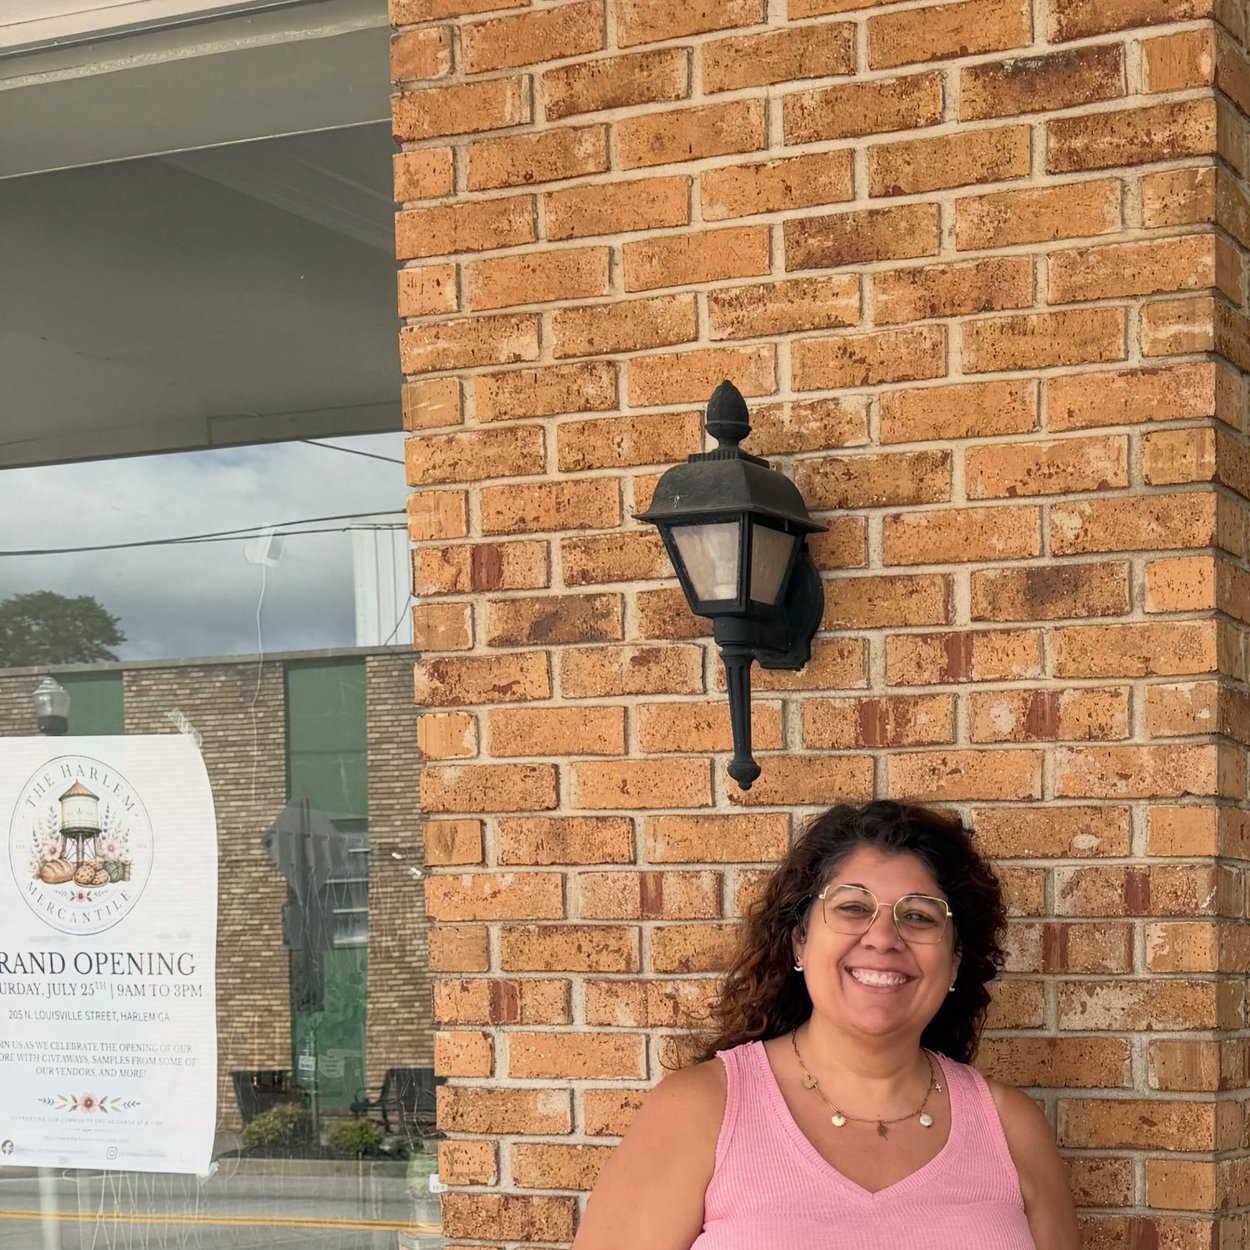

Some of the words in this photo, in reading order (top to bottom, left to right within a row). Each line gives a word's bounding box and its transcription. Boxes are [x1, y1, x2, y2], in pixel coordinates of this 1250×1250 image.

[25, 772, 55, 808] THE
[60, 763, 135, 812] HARLEM
[25, 881, 131, 924] MERCANTILE
[0, 951, 65, 974] RAND
[74, 952, 196, 976] OPENING
[0, 982, 44, 997] URDAY,
[46, 982, 77, 999] JULY
[117, 983, 146, 997] 9AM
[148, 984, 170, 997] TO
[174, 984, 203, 998] 3PM
[8, 1009, 23, 1020] 205
[35, 1010, 82, 1021] LOUISVILLE
[84, 1010, 119, 1023] STREET,
[120, 1011, 156, 1022] HARLEM
[0, 1040, 10, 1050] IN
[12, 1041, 23, 1050] US
[24, 1041, 35, 1050] AS
[35, 1041, 49, 1050] WE
[50, 1041, 98, 1052] CELEBRATE
[100, 1042, 117, 1052] THE
[119, 1043, 159, 1053] OPENING
[173, 1044, 193, 1054] OUR
[17, 1053, 40, 1062] WITH
[91, 1055, 130, 1065] SAMPLES
[131, 1056, 157, 1066] FROM
[158, 1056, 183, 1067] SOME
[35, 1066, 54, 1076] OUR
[98, 1068, 118, 1078] AND
